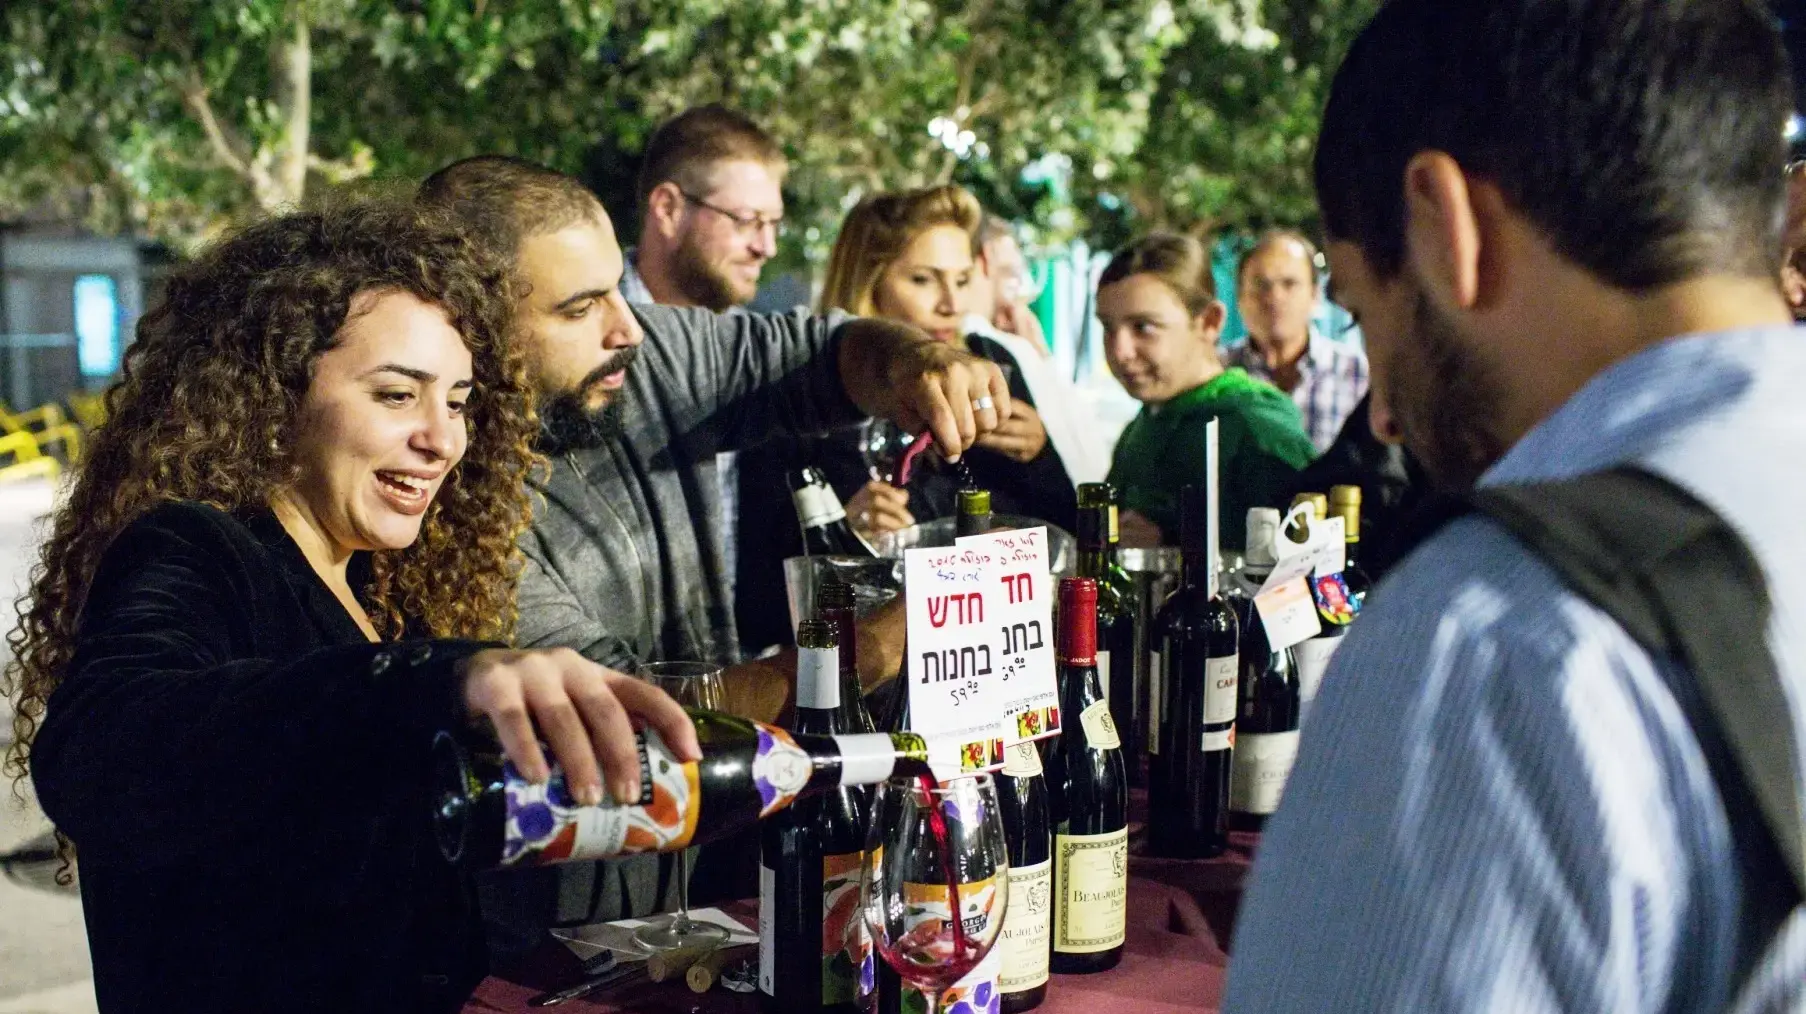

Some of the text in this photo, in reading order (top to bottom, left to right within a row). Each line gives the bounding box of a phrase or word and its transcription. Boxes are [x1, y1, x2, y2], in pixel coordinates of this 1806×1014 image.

[1001, 572, 1033, 604] חד
[927, 592, 984, 628] חדש
[1002, 620, 1044, 655] בחנ
[921, 644, 993, 684] בחנות
